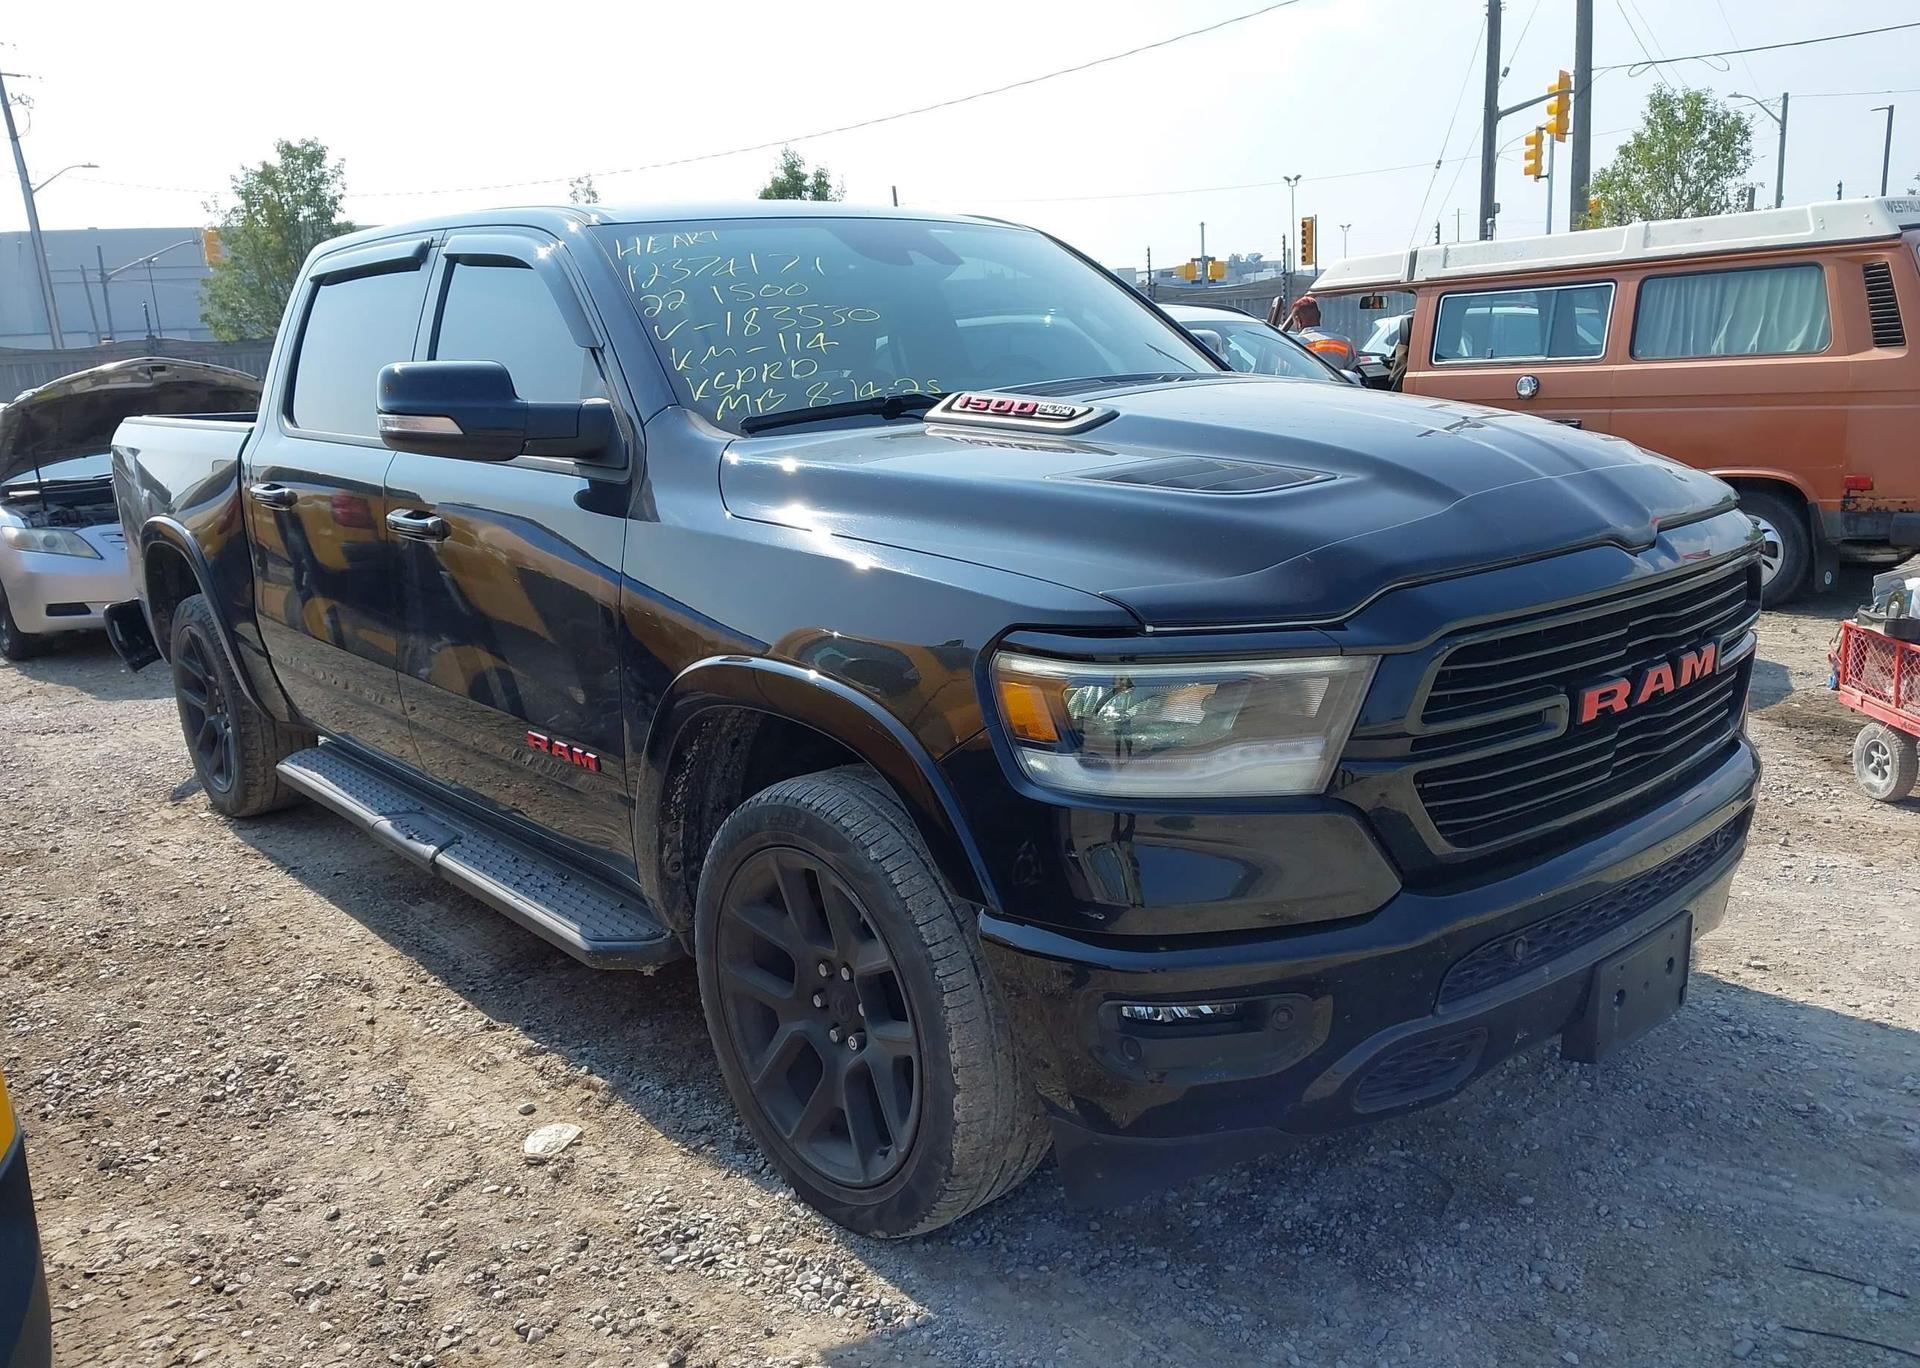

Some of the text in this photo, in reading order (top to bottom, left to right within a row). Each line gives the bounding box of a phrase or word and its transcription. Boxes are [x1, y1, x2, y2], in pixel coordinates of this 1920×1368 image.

[615, 230, 719, 260] HEART
[640, 282, 809, 318] 22 1500
[958, 394, 1038, 415] 1500
[1580, 641, 1717, 724] RAM
[527, 730, 601, 772] RAM
